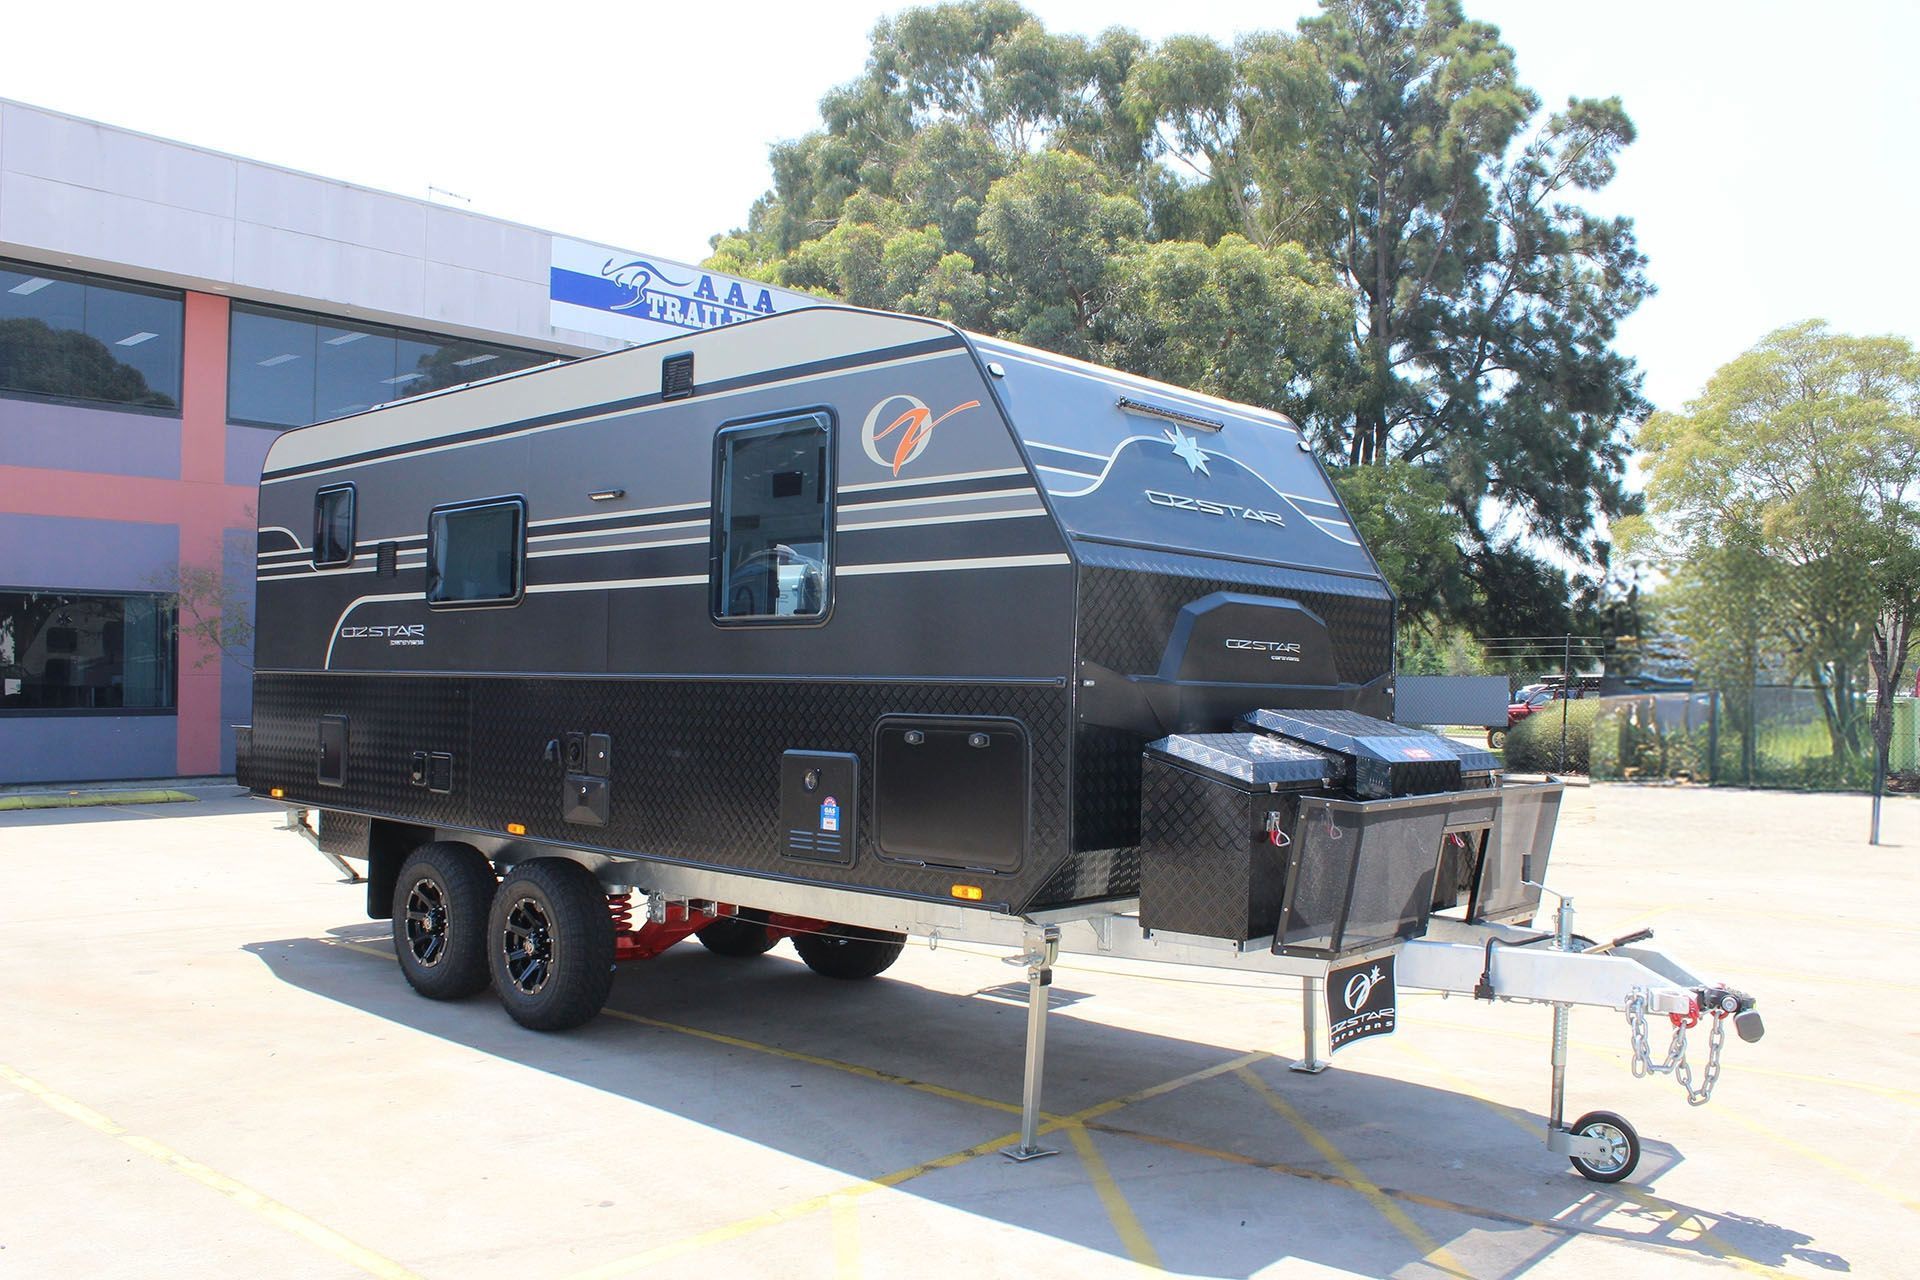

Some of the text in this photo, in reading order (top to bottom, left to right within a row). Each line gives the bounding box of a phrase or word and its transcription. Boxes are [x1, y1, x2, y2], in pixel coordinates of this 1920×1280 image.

[646, 291, 758, 329] TRAIL
[1145, 490, 1286, 527] OZSTAR
[341, 624, 425, 638] OZSTAR
[1225, 638, 1301, 654] OZSTAR
[1331, 1020, 1394, 1046] aravans
